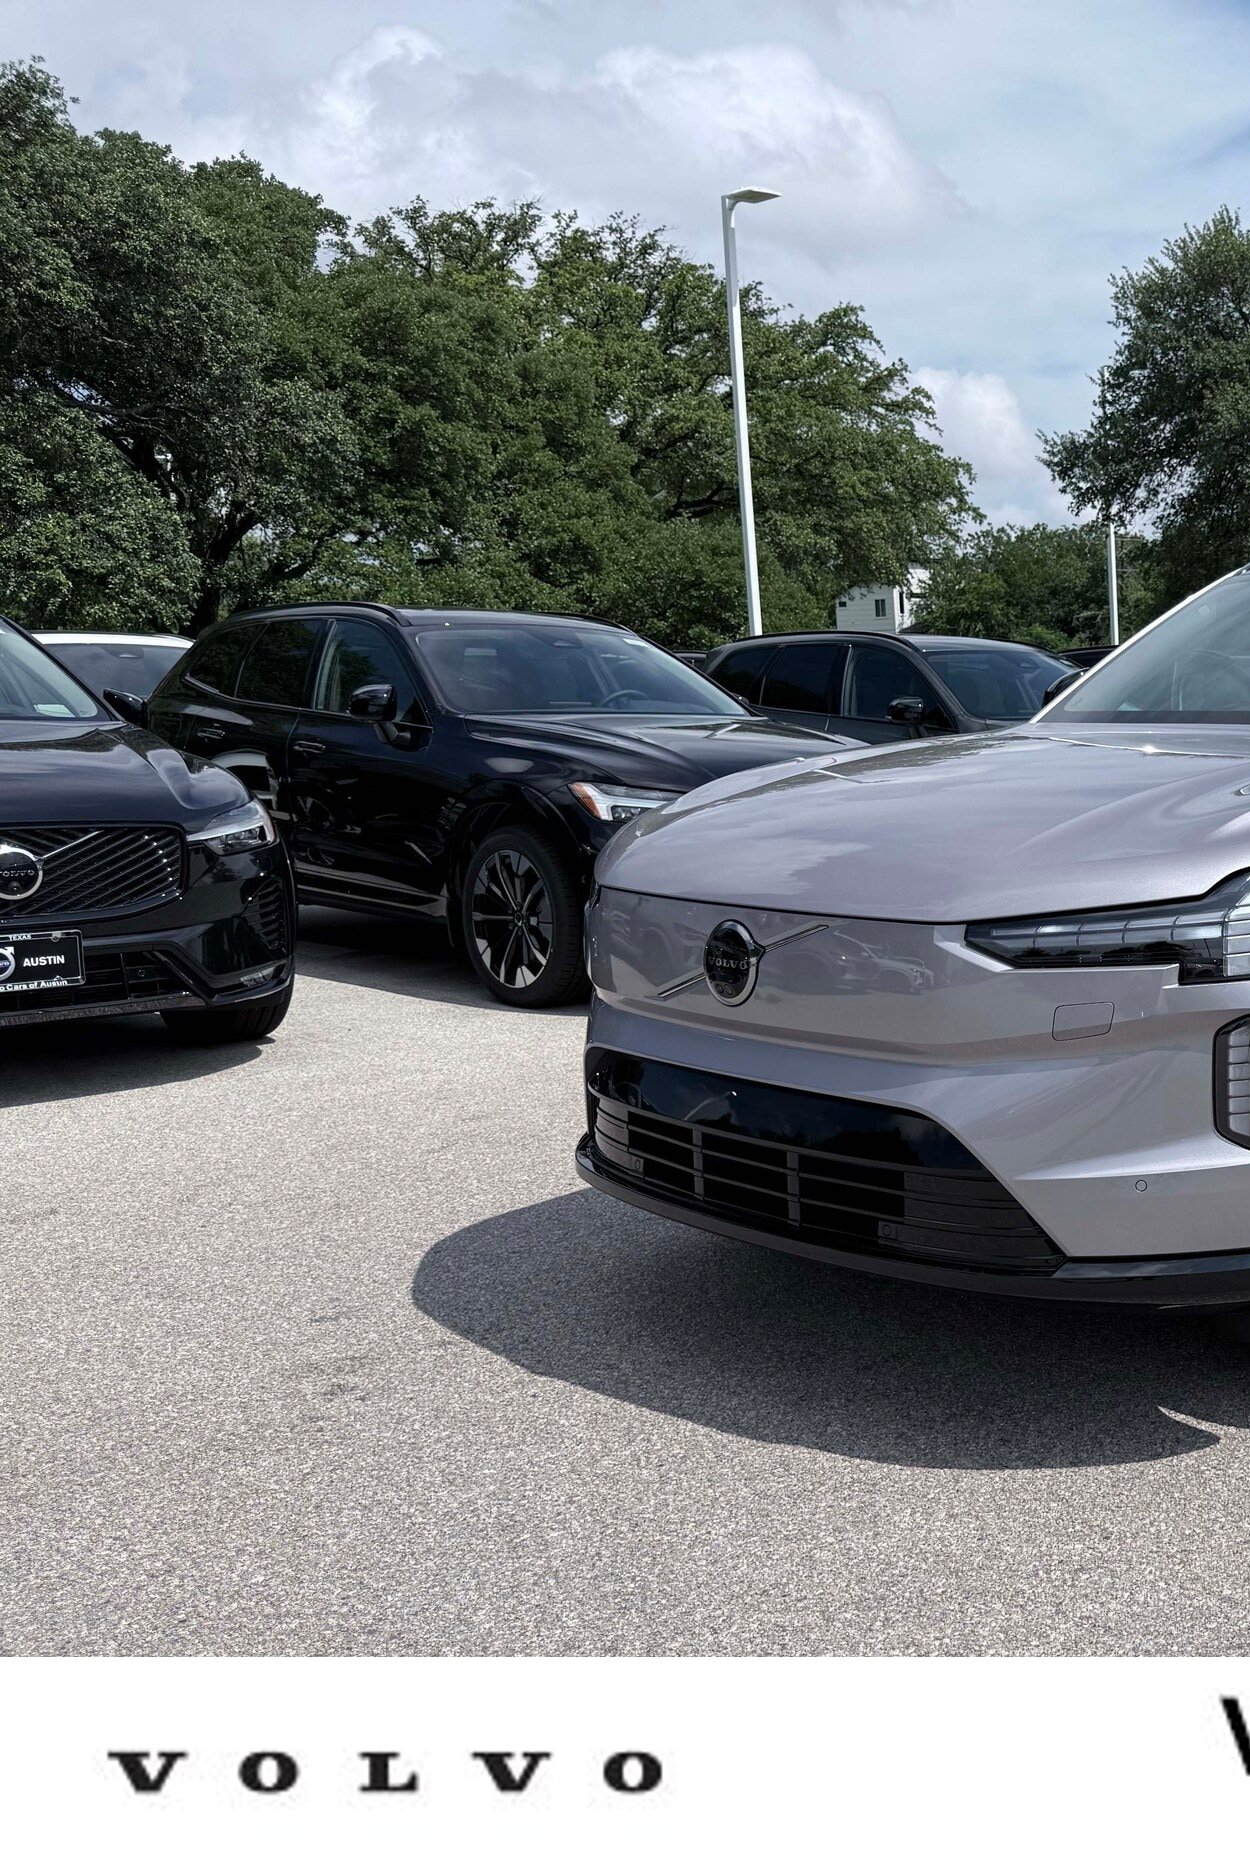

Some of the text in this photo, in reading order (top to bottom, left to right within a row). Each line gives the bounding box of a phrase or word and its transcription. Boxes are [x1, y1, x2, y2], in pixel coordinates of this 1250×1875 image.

[0, 869, 35, 877] OLVO
[9, 933, 32, 941] TEXAS
[23, 955, 65, 967] AUSTIN
[709, 956, 748, 970] VOLVO
[6, 983, 27, 992] Cars
[41, 979, 68, 988] Austin
